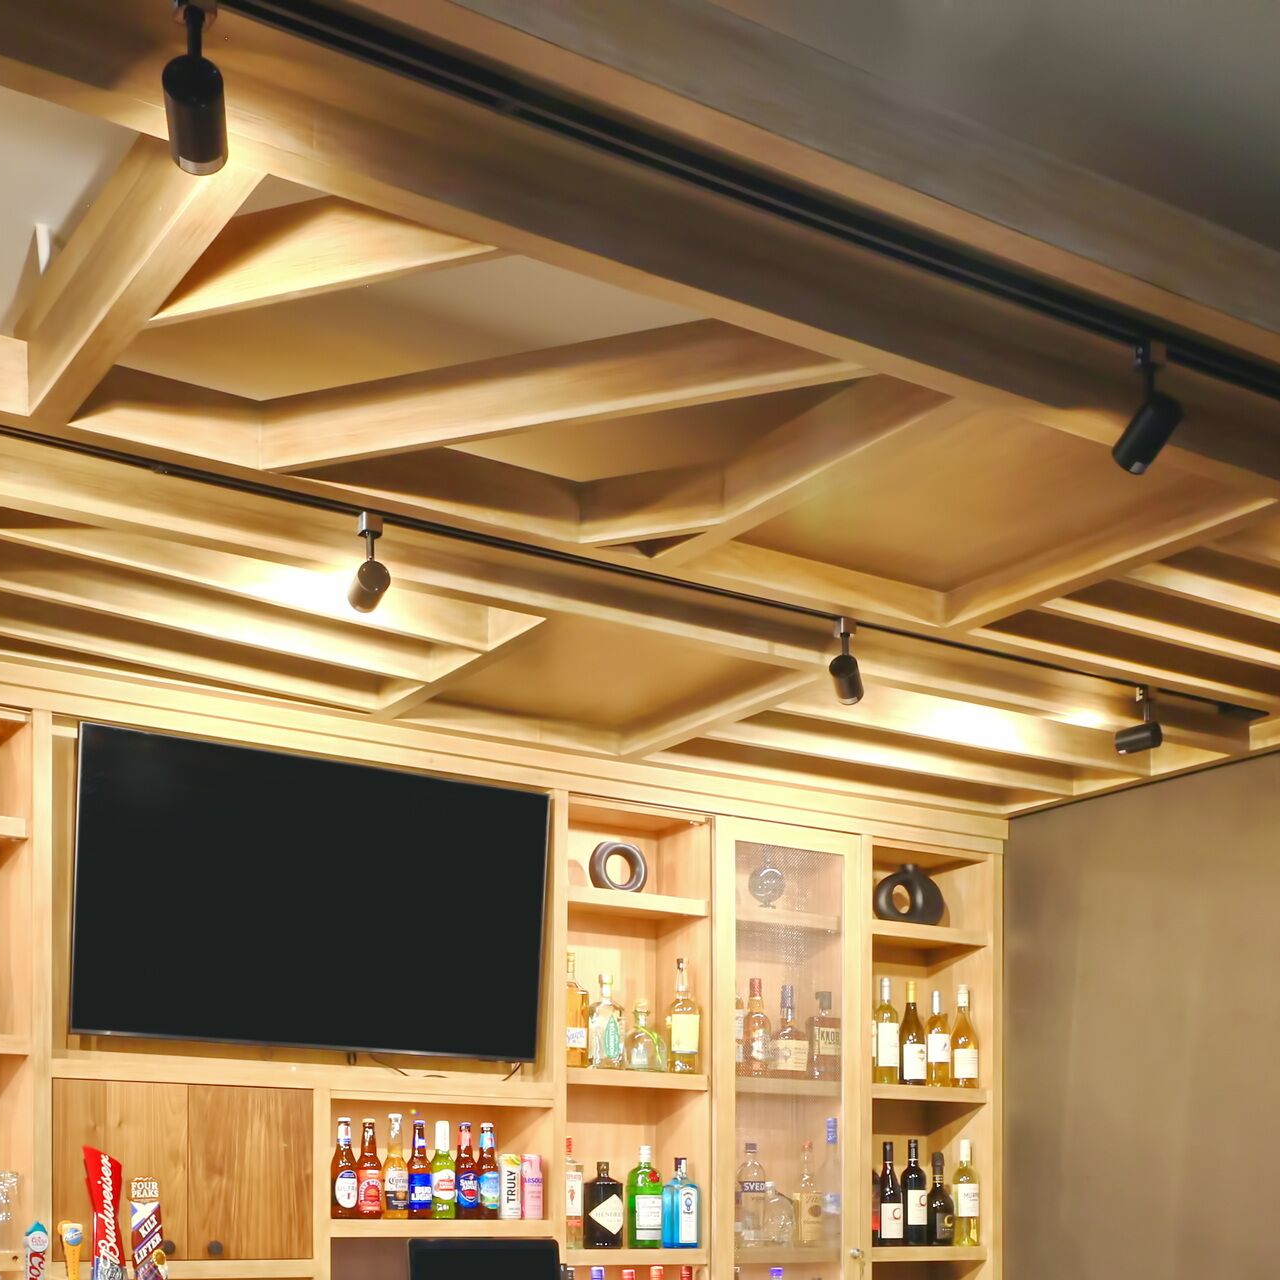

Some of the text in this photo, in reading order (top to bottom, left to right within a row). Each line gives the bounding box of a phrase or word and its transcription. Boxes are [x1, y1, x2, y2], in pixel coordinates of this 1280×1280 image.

[131, 1181, 159, 1191] FOUR
[131, 1189, 159, 1198] PEAKS
[506, 1170, 516, 1204] TRULY
[743, 1182, 766, 1191] SVED
[411, 1193, 432, 1201] LIGH
[97, 1154, 120, 1269] Budweiser
[138, 1213, 158, 1239] KILT
[133, 1232, 162, 1265] LIFTER
